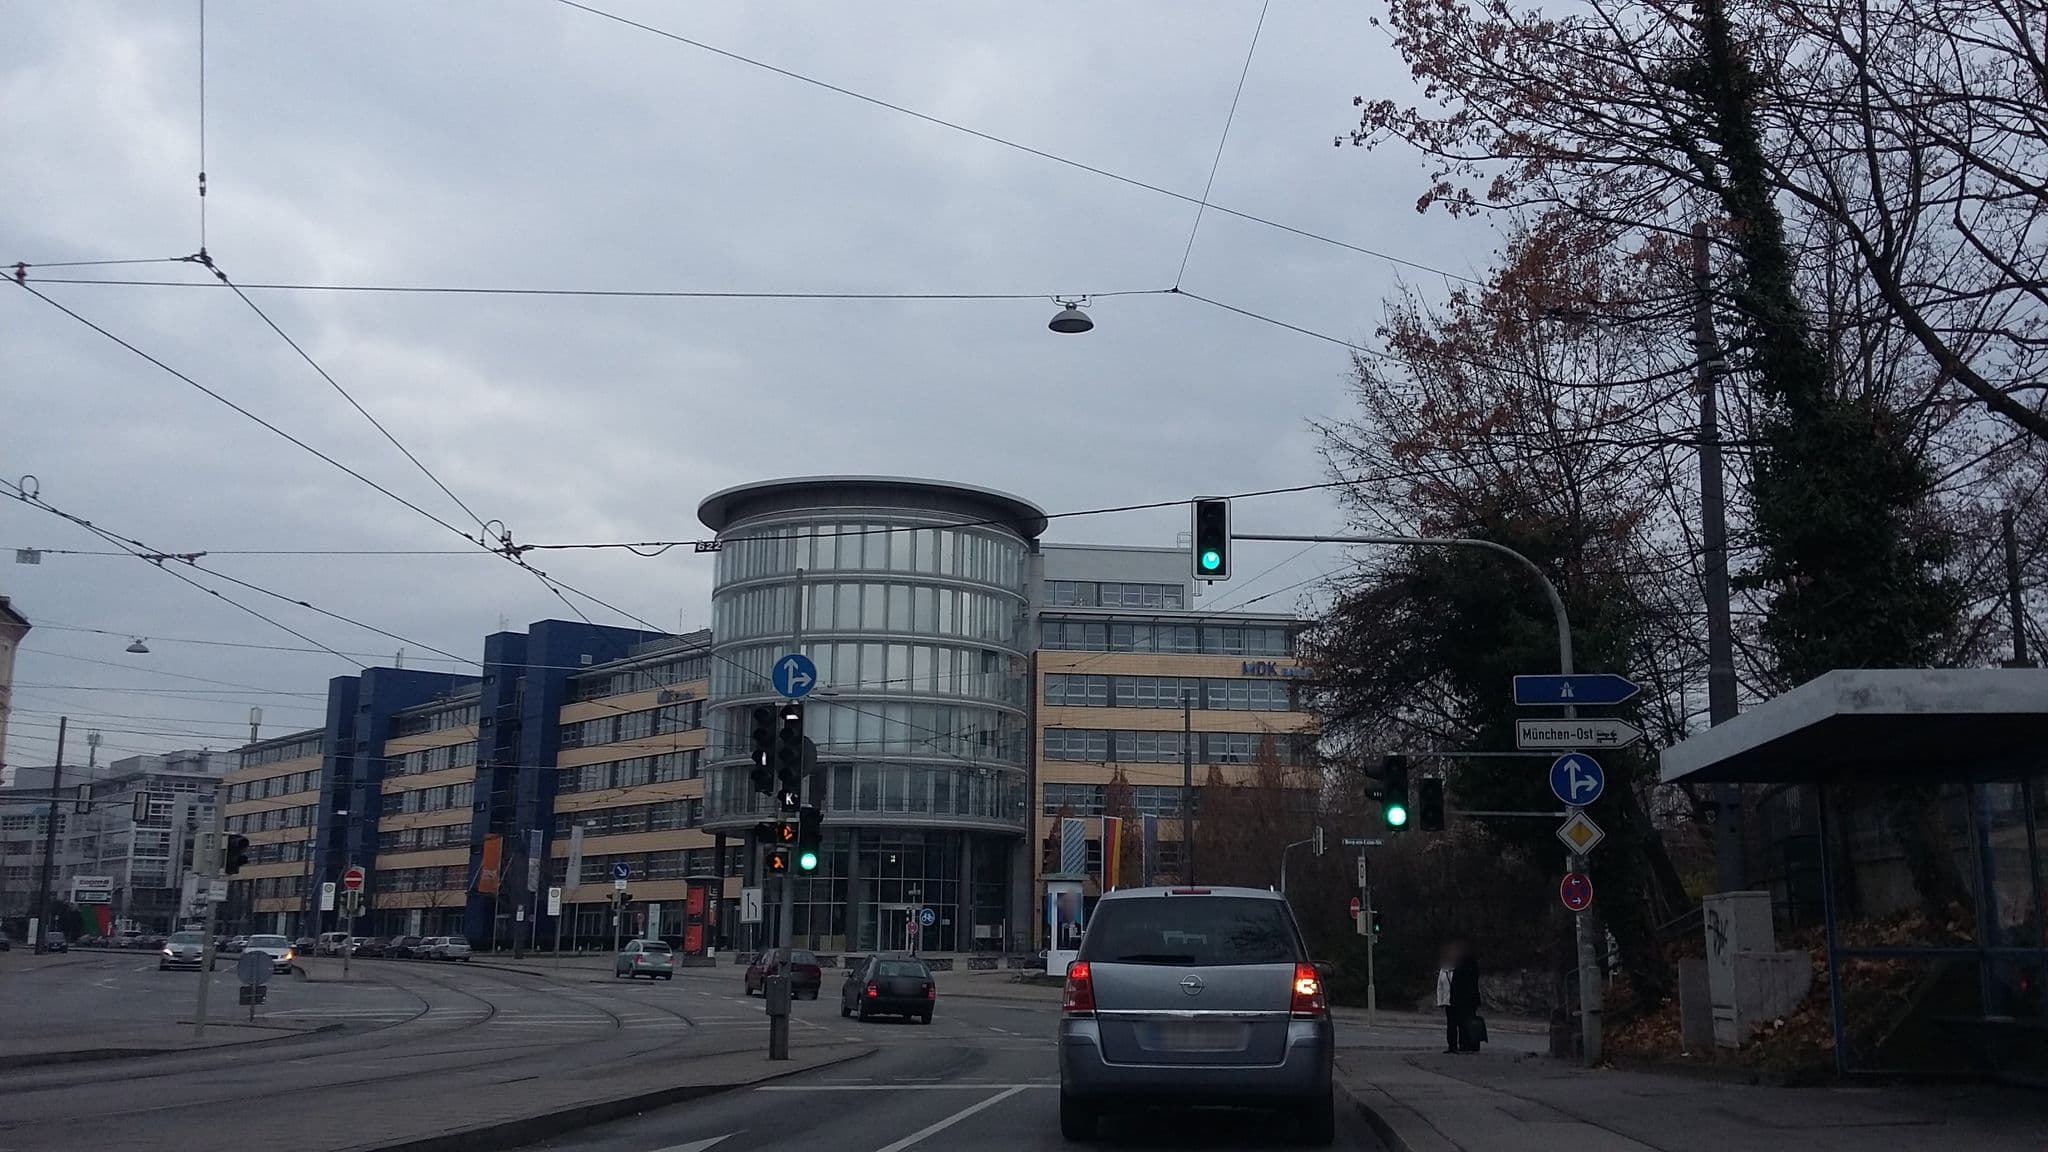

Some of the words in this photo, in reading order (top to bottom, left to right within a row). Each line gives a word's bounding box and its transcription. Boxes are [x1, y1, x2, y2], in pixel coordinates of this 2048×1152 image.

[1242, 660, 1279, 677] MDK
[1522, 727, 1593, 740] München-Ost
[785, 793, 794, 805] K
